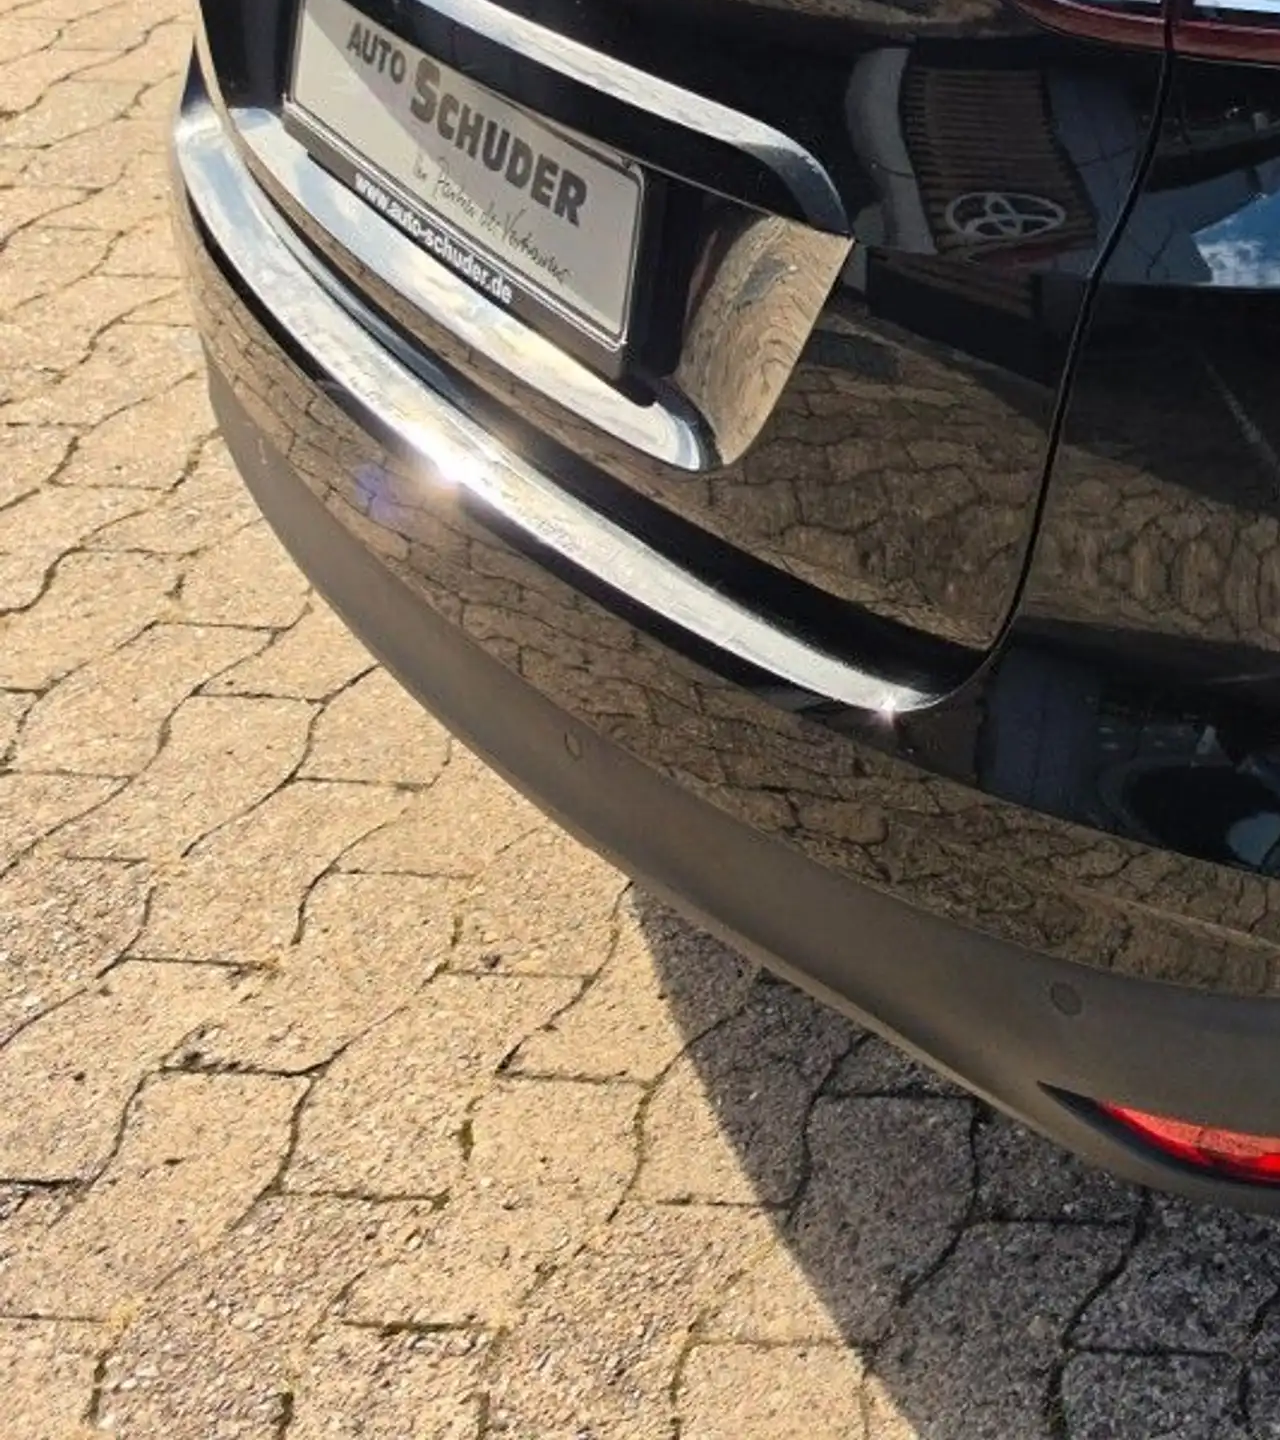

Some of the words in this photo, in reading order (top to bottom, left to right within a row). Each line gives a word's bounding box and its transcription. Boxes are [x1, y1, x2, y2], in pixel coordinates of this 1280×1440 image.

[346, 22, 407, 85] AUTO
[409, 56, 588, 228] SCHUDER
[354, 171, 513, 305] www.auto-schuder.de
